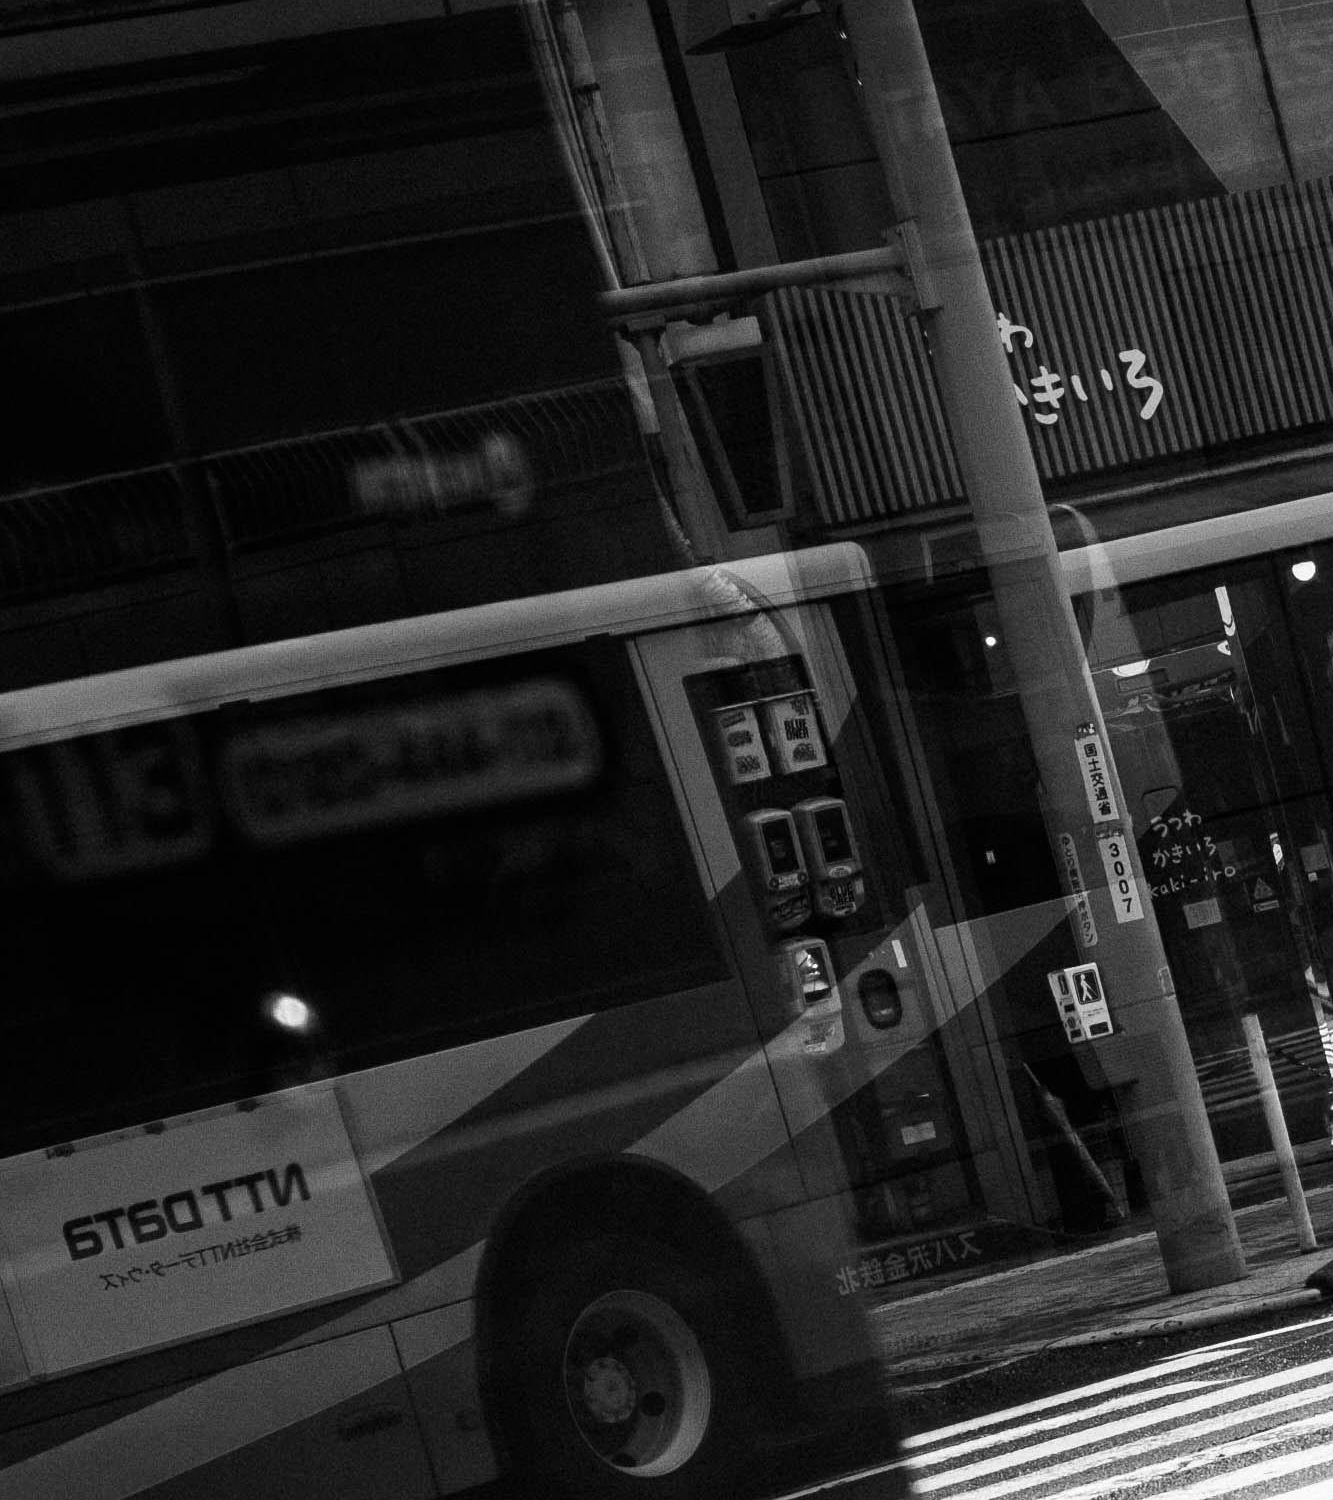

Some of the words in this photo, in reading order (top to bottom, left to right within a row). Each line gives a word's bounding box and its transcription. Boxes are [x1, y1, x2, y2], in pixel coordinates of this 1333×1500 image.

[1013, 348, 1164, 426] きいろ
[1083, 742, 1113, 817] 国土交通省
[1151, 807, 1203, 839] うつわ
[1108, 842, 1134, 914] 3007
[1152, 834, 1218, 869] かきいろ
[1148, 864, 1238, 900] kaki-iro
